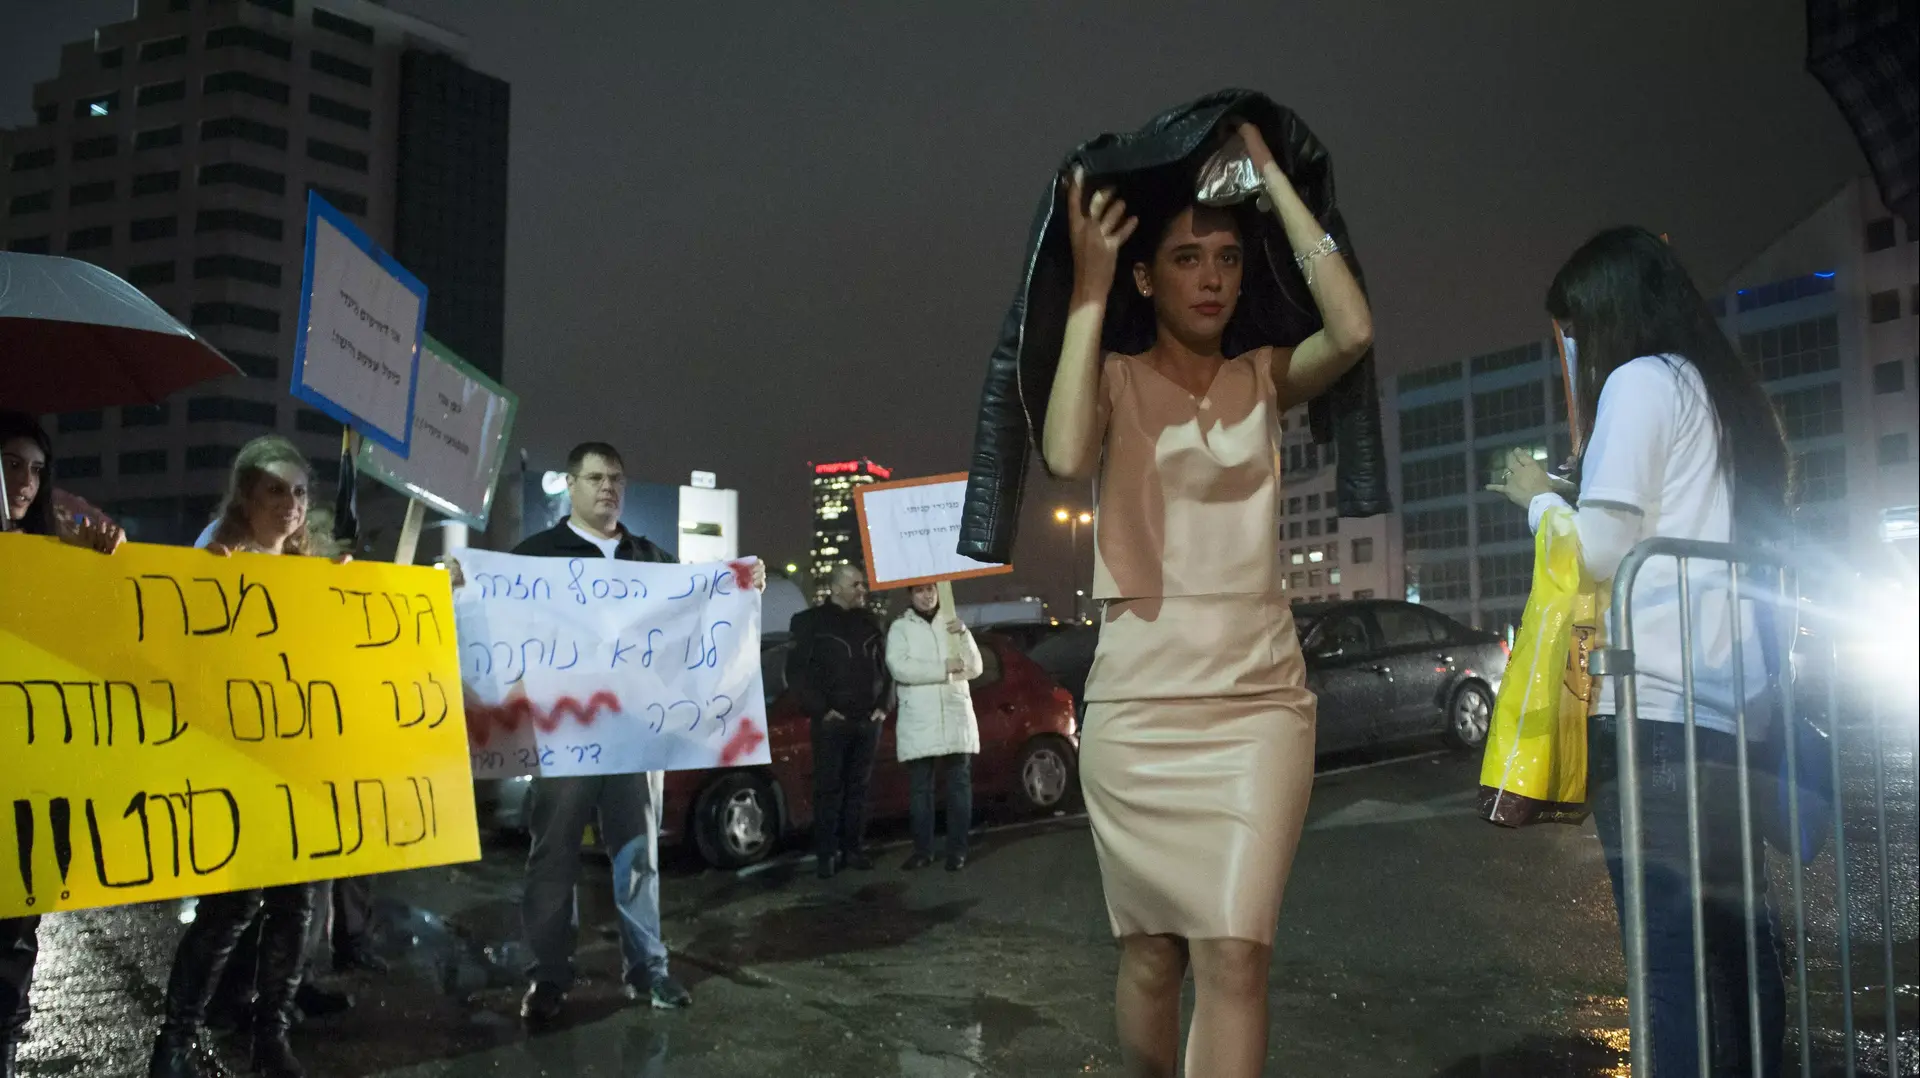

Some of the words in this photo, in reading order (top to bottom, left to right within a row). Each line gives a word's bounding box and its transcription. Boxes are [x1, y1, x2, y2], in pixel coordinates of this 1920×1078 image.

[475, 573, 551, 600] חזרה
[568, 558, 648, 605] הכסף
[668, 570, 731, 600] את
[126, 573, 278, 642] מכרו
[329, 587, 442, 648] גינדי
[468, 637, 578, 685] נותרה
[611, 629, 663, 668] לא
[684, 621, 731, 670] לנו
[226, 653, 343, 742] חלום
[647, 695, 733, 736] דירה
[276, 776, 436, 860] ונתנו
